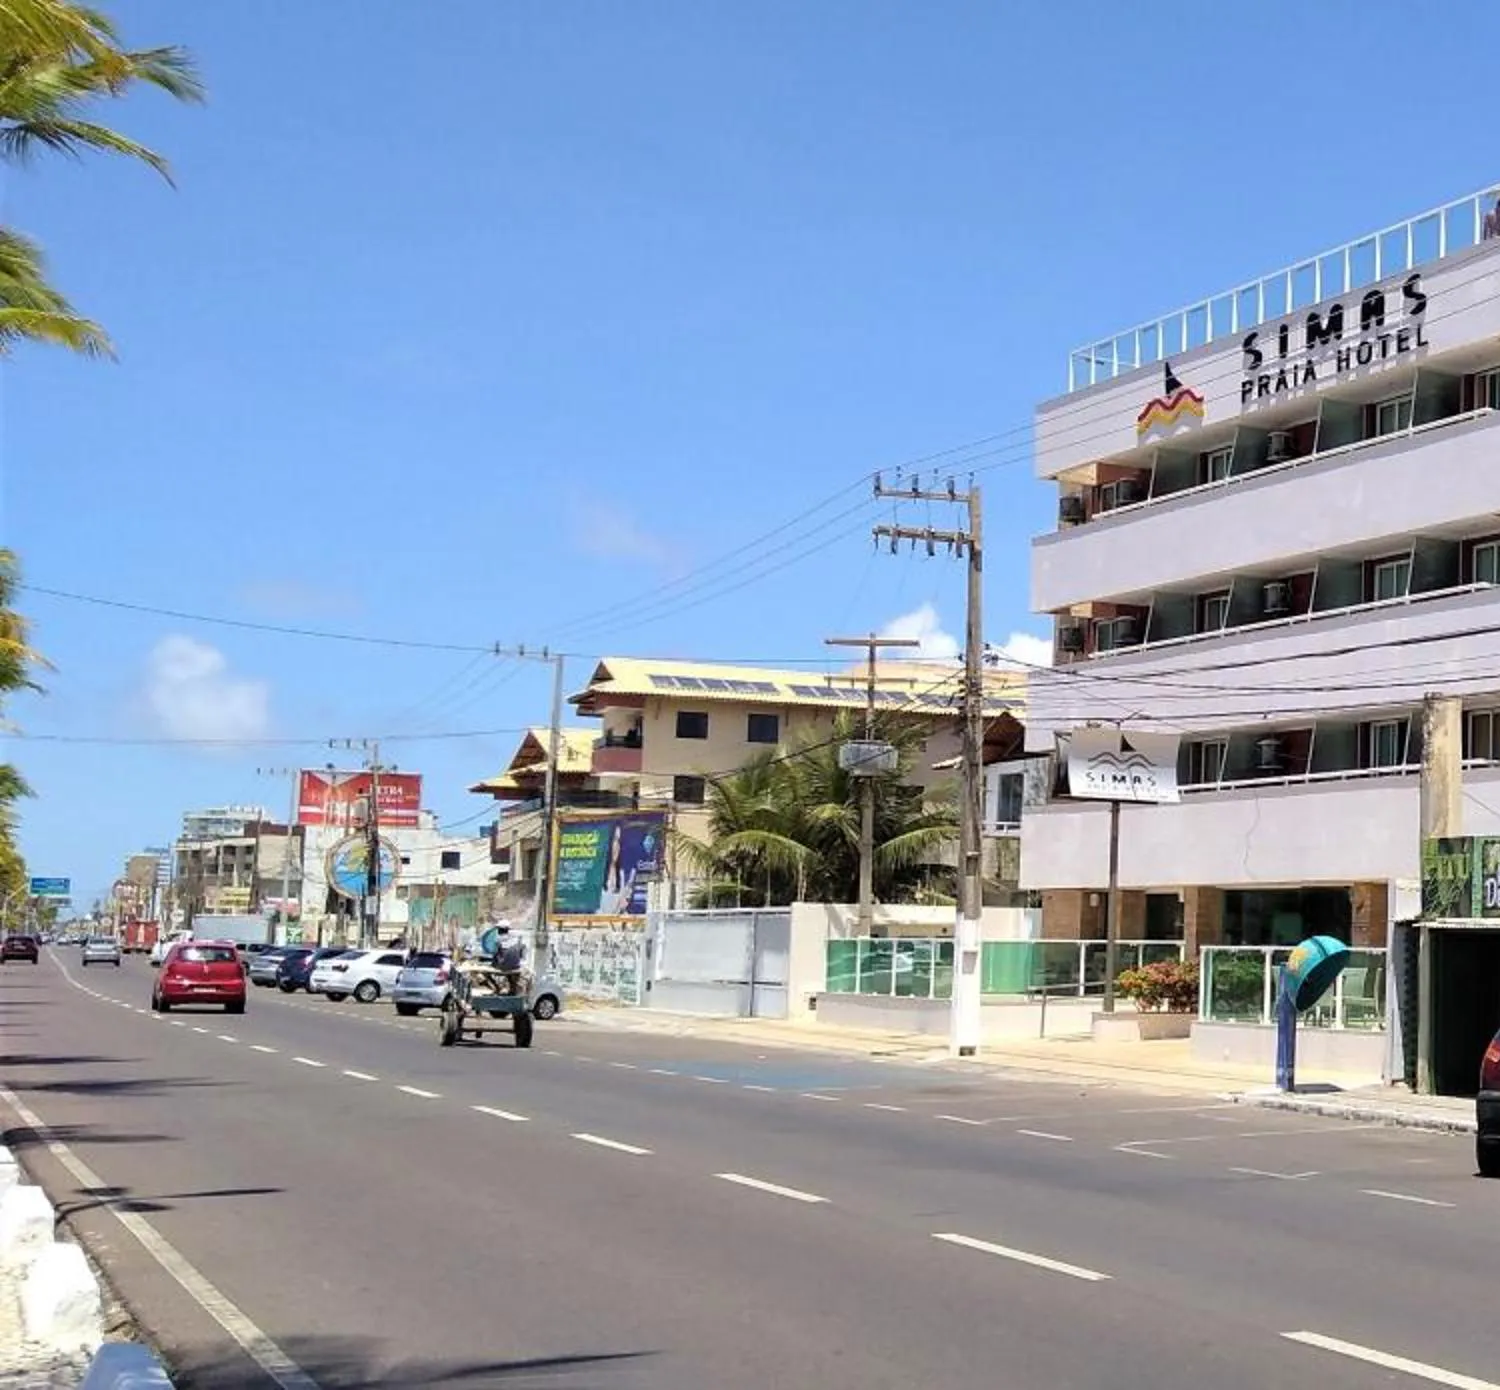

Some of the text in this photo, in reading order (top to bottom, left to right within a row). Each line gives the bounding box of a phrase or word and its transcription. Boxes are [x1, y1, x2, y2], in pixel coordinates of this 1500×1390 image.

[1242, 273, 1428, 370] SIMAS
[1241, 324, 1429, 405] PRAIA HOTEL
[1086, 771, 1156, 786] SIMAS
